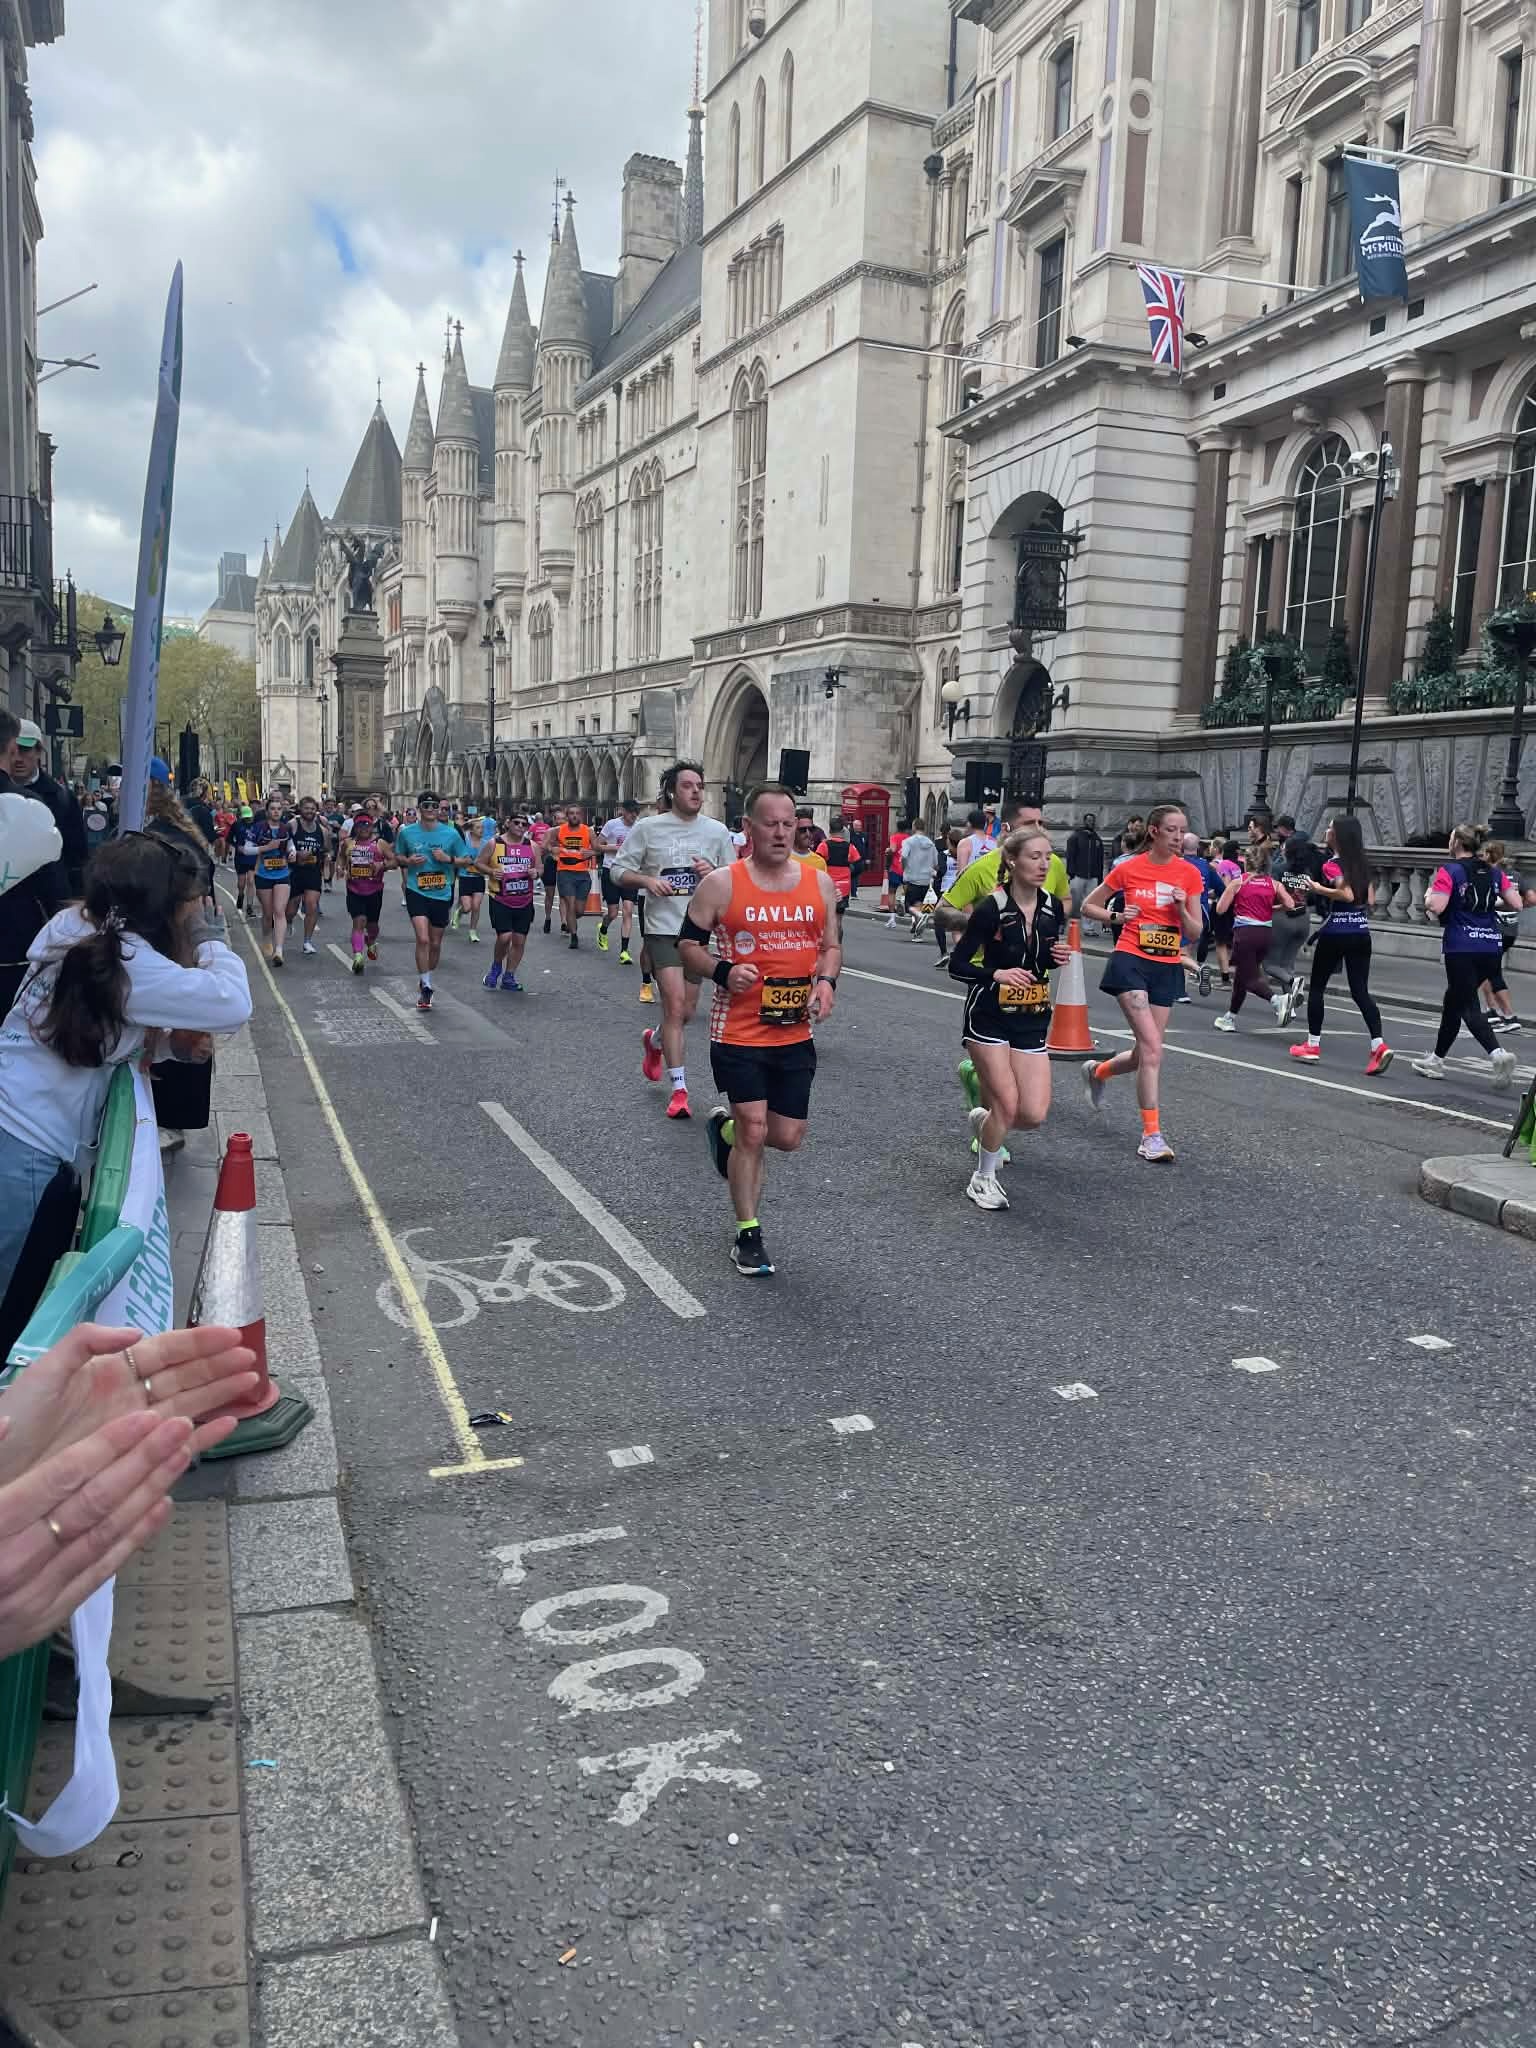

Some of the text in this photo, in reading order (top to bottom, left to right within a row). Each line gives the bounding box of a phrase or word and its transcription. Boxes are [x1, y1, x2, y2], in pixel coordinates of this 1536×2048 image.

[745, 905, 814, 922] GAVLAR
[758, 930, 786, 940] saving
[1147, 933, 1175, 946] 3582
[759, 940, 801, 951] rebuilding
[486, 1526, 762, 1826] LOOK
